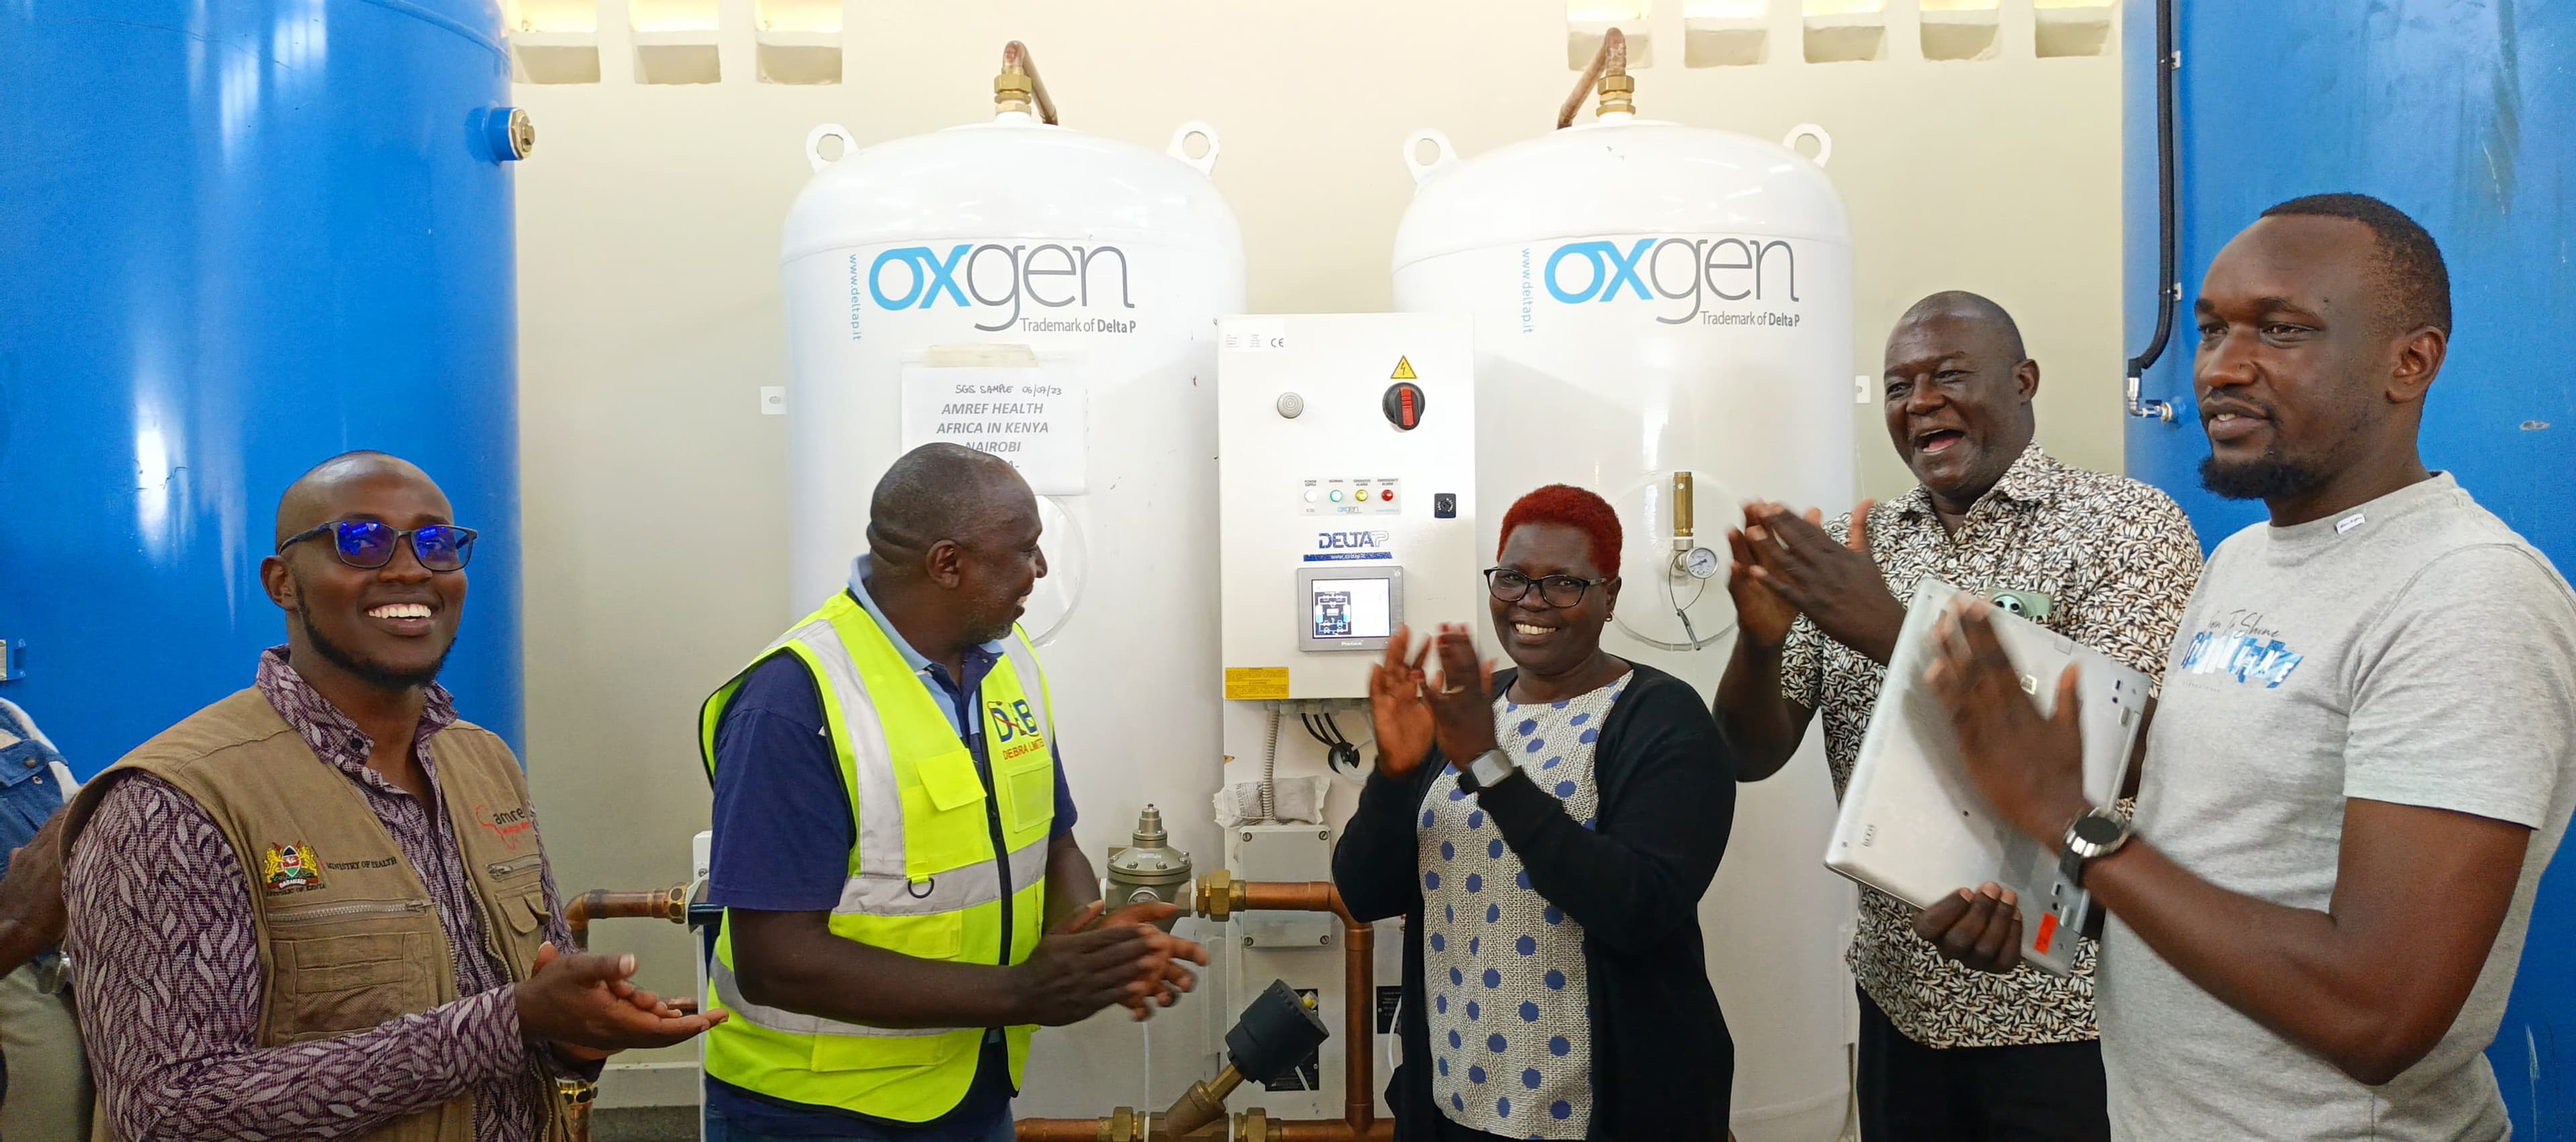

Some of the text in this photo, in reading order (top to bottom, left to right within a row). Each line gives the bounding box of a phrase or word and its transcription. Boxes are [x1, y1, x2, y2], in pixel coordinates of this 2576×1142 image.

[869, 244, 1135, 331] oxgen
[1544, 238, 1800, 325] oxgen
[849, 253, 861, 342] www.deltap.it
[1521, 248, 1534, 333] www.deltap.it
[1019, 317, 1136, 333] Trademark of Delta P
[1700, 311, 1800, 327] Trademark of Delta P
[955, 384, 975, 394] SGS
[980, 384, 1014, 394] SAMPLE
[941, 403, 1043, 415] AMREF HEALTH
[936, 422, 1049, 434] AFRICA IN KENYA
[1003, 743, 1029, 760] DEBRA
[493, 808, 525, 825] amre
[326, 861, 360, 870] MINISTRY
[362, 860, 370, 868] OF
